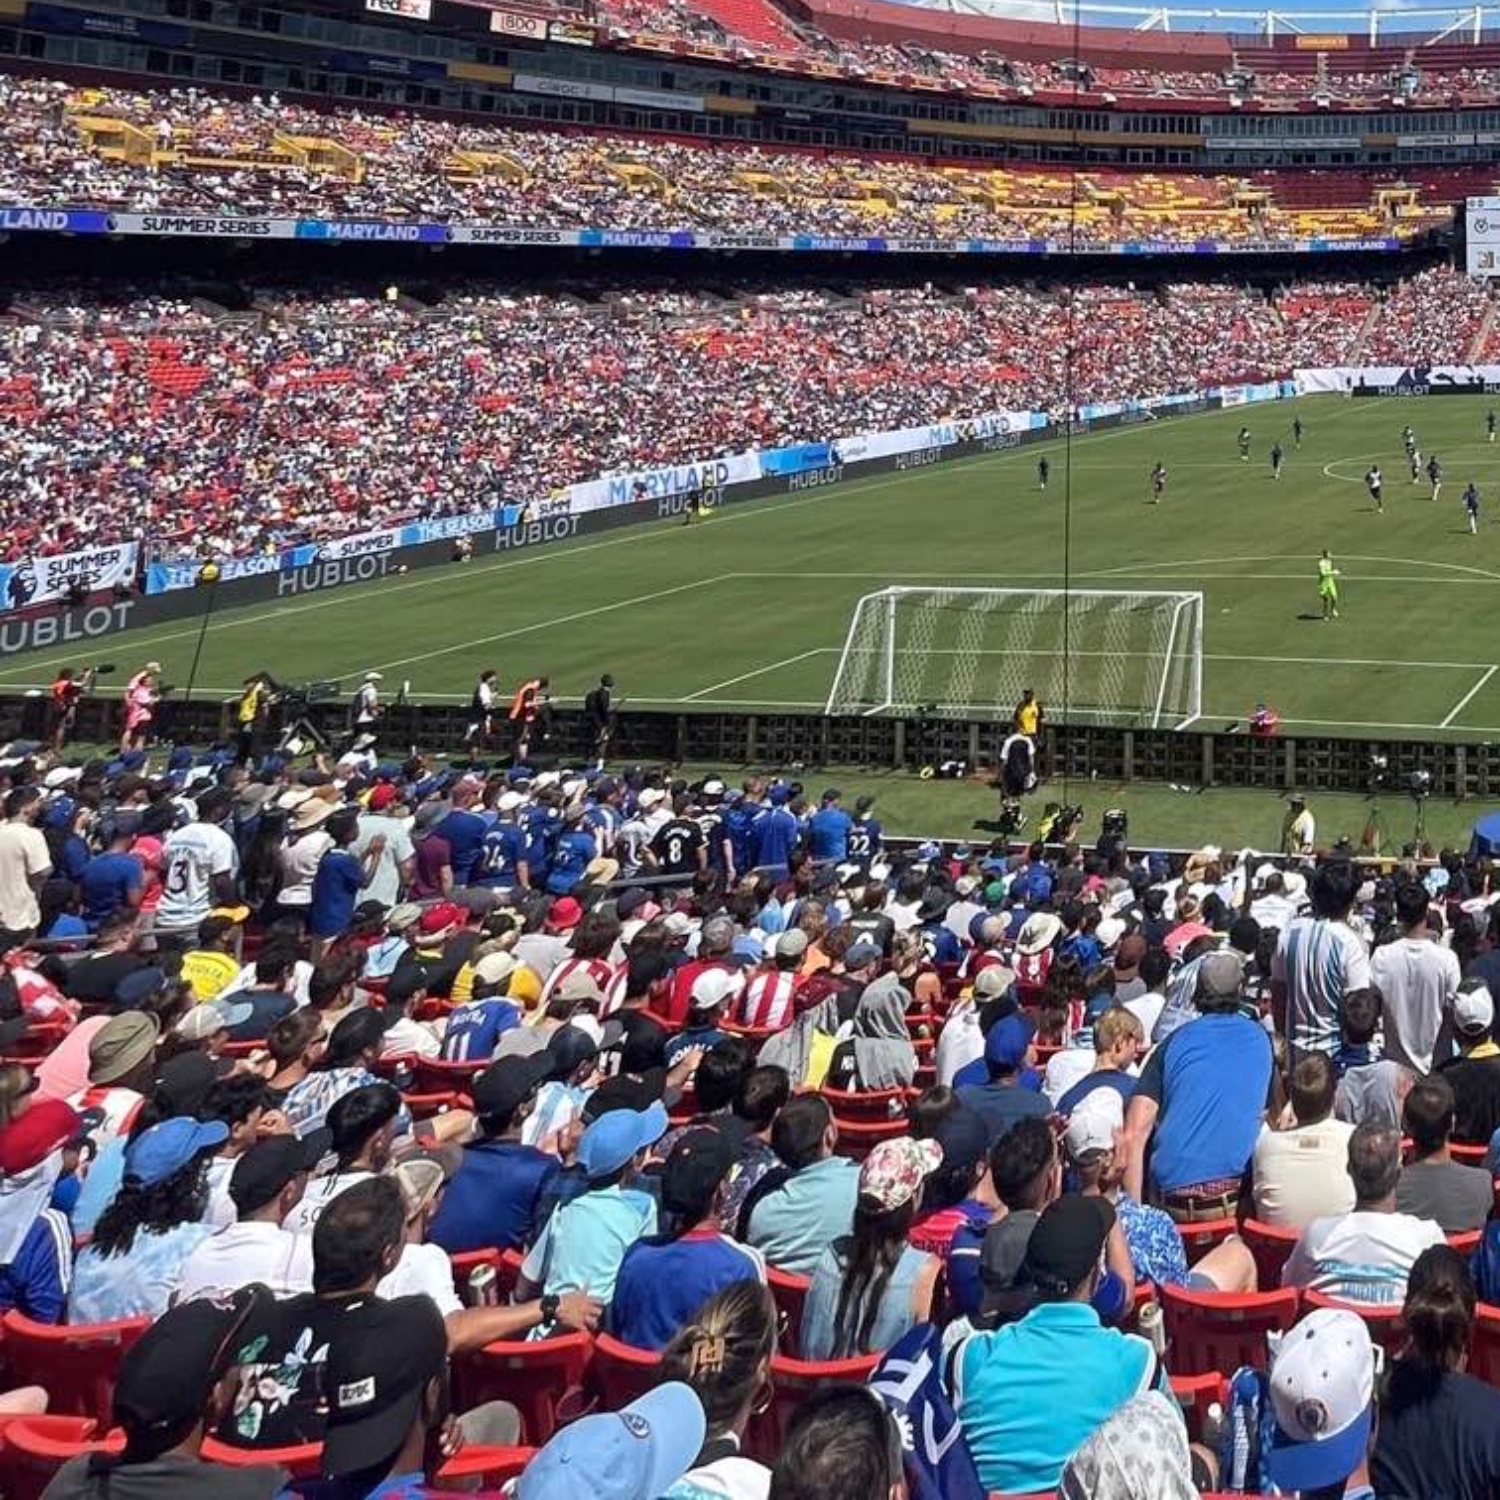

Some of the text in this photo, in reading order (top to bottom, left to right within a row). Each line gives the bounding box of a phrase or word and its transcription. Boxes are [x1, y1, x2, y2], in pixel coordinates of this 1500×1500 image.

[142, 217, 271, 235] SUMMER SERIES
[326, 224, 420, 241] MARYLAND
[470, 229, 561, 244] SUMMER SERIES
[602, 231, 671, 246] MARYLAND
[1378, 384, 1431, 396] HUBLOT
[895, 448, 942, 469] HUBLOT
[789, 465, 844, 490] HUBLOT
[420, 522, 448, 541] THE
[494, 514, 582, 550] HUBLOT
[341, 534, 394, 557] SUMMER
[48, 550, 120, 577] SUMMER
[278, 551, 394, 595] HUBLOT
[669, 838, 682, 863] 8
[849, 835, 870, 855] 22
[446, 1031, 471, 1062] 11
